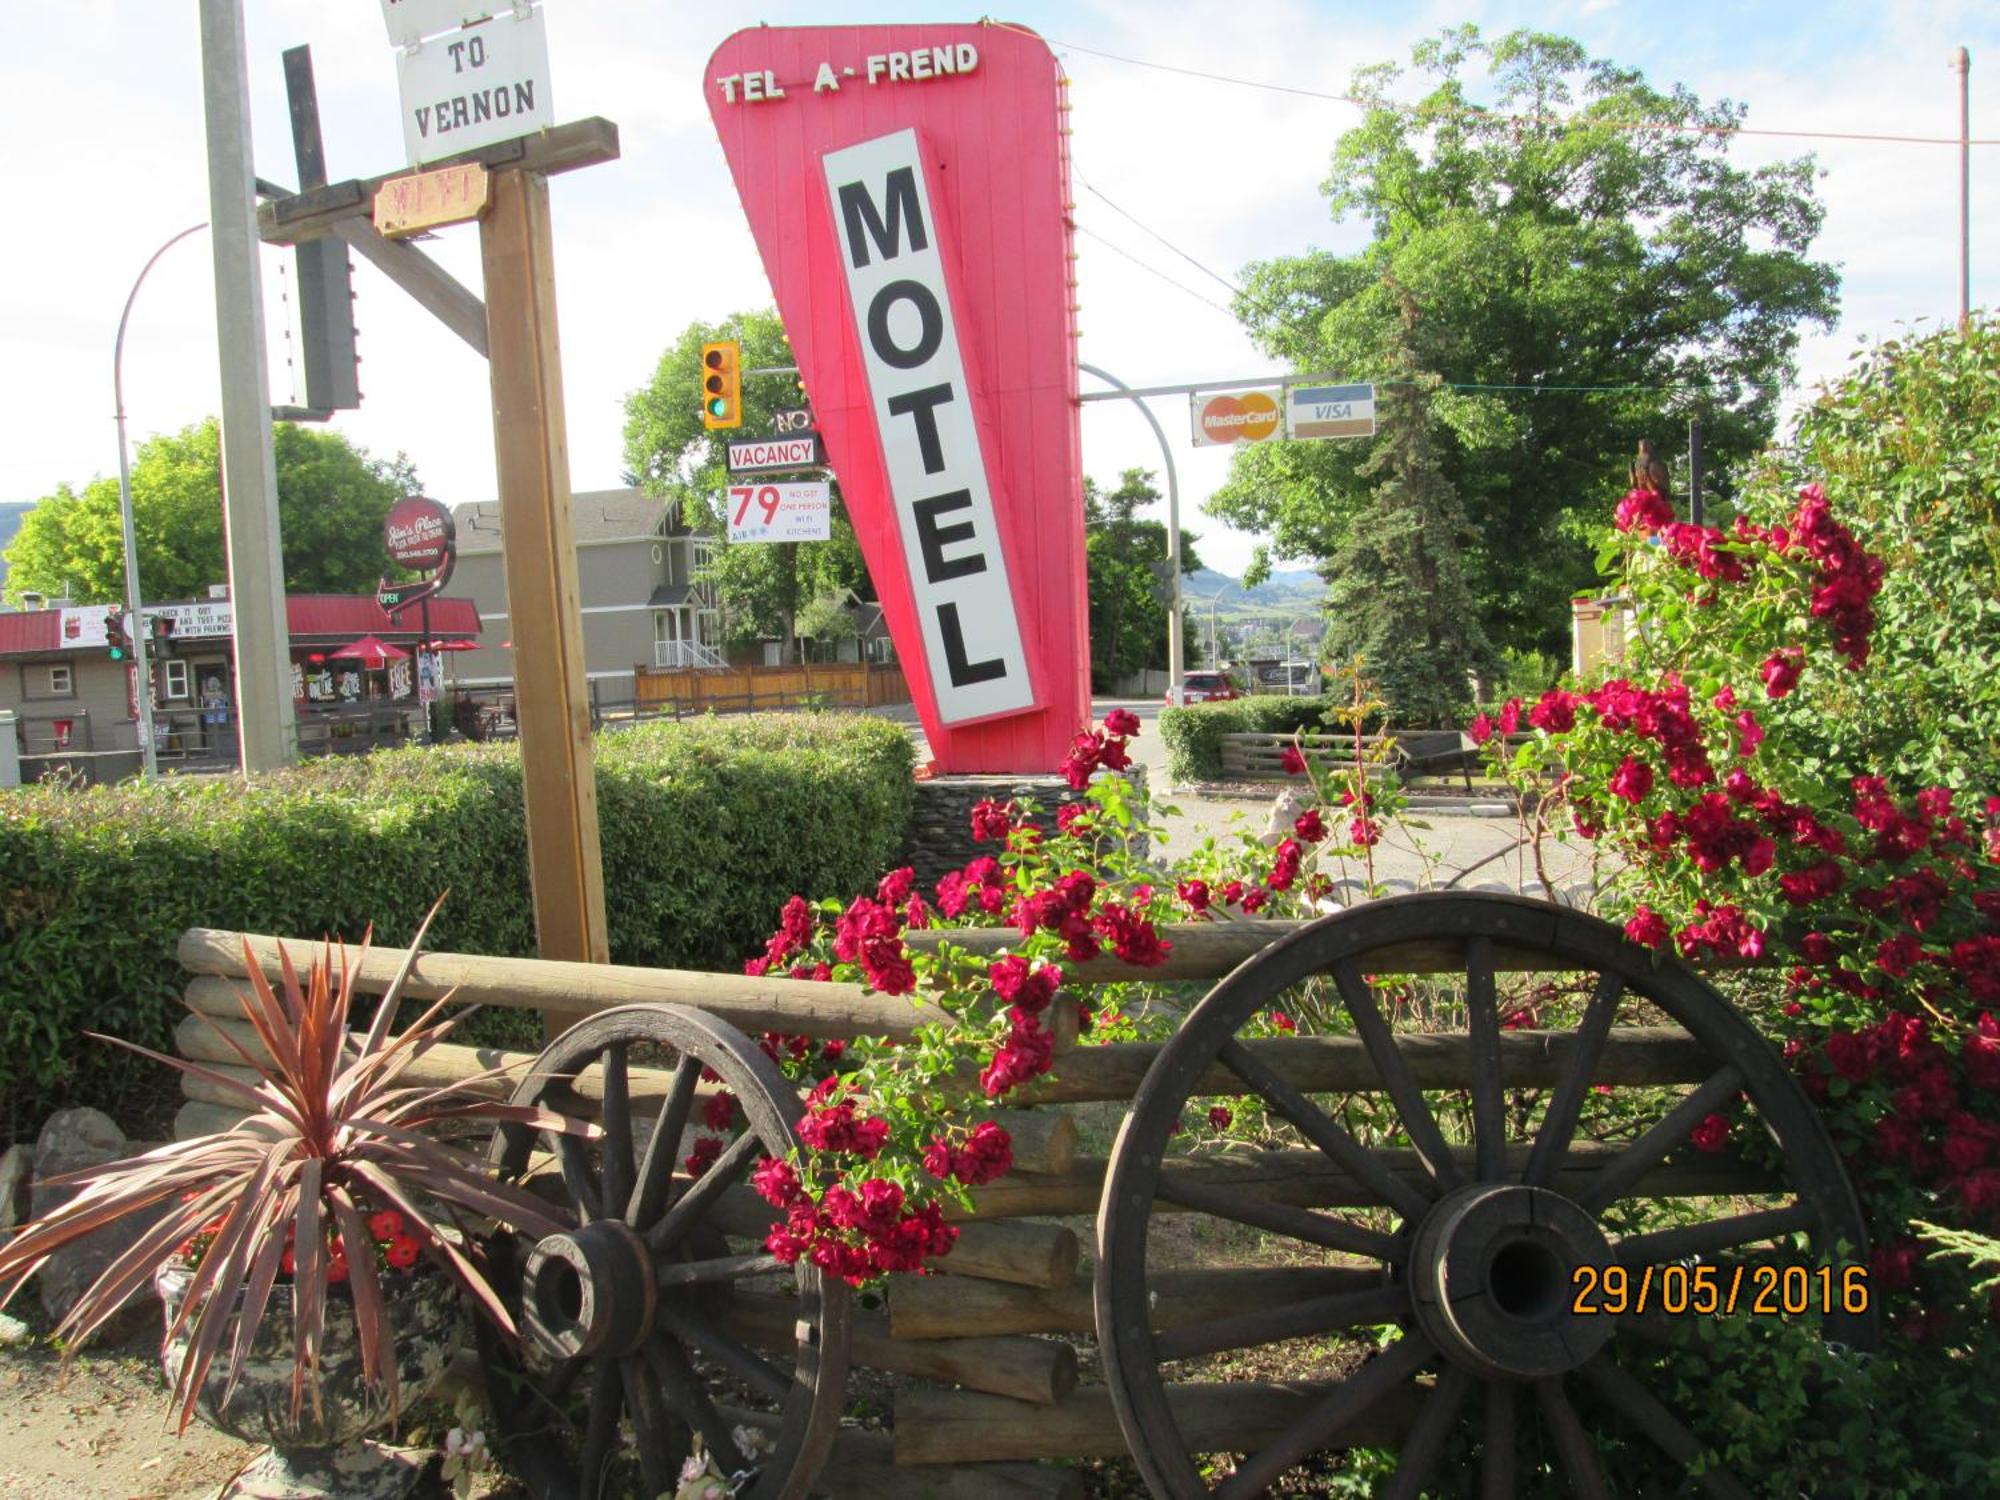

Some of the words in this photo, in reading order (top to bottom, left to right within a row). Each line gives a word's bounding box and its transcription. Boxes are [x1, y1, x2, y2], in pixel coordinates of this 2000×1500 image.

[447, 35, 486, 73] TO
[717, 70, 785, 103] TEL
[415, 79, 535, 138] VERNON
[776, 410, 809, 432] NO
[1204, 410, 1277, 428] MasterCard
[1314, 404, 1353, 419] VISA
[838, 165, 1007, 688] MOTEL
[731, 442, 812, 466] VACANCY
[731, 486, 780, 526] 79
[798, 501, 828, 511] PERSON
